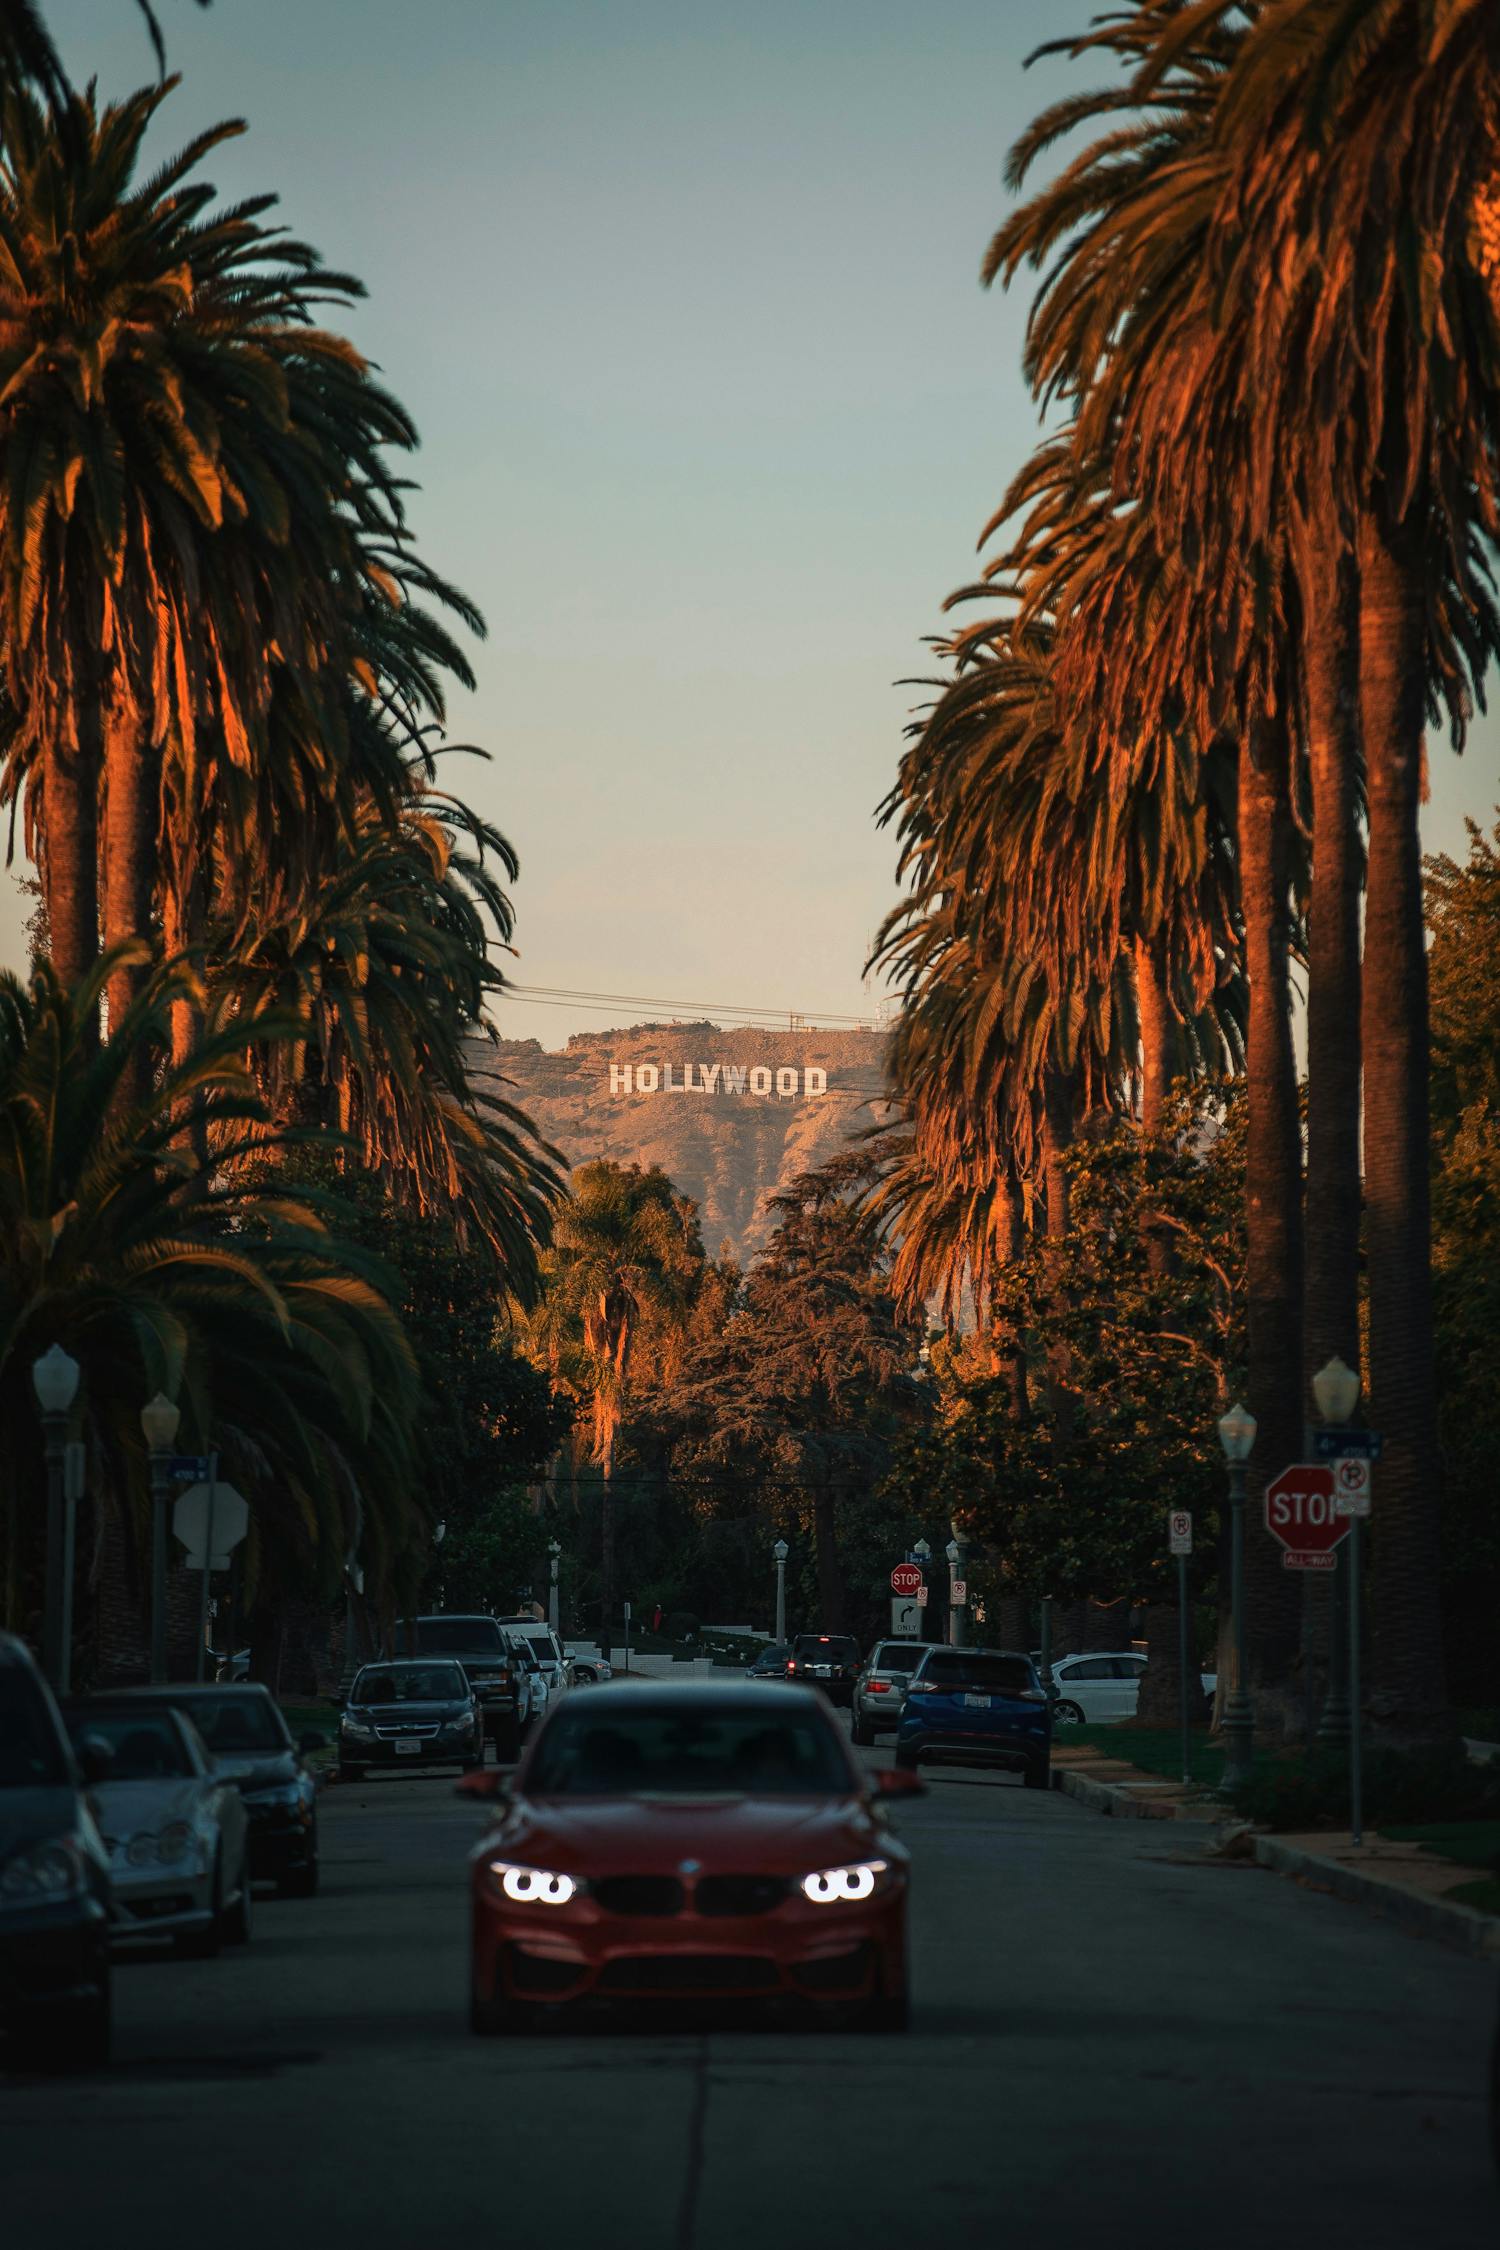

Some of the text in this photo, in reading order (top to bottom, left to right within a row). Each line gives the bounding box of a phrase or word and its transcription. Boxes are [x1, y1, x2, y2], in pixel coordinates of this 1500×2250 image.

[610, 1064, 828, 1097] HOLLYWOOD
[1286, 1555, 1334, 1566] ALL-WAY
[893, 1573, 920, 1586] STOP
[897, 1624, 917, 1632] ONLY
